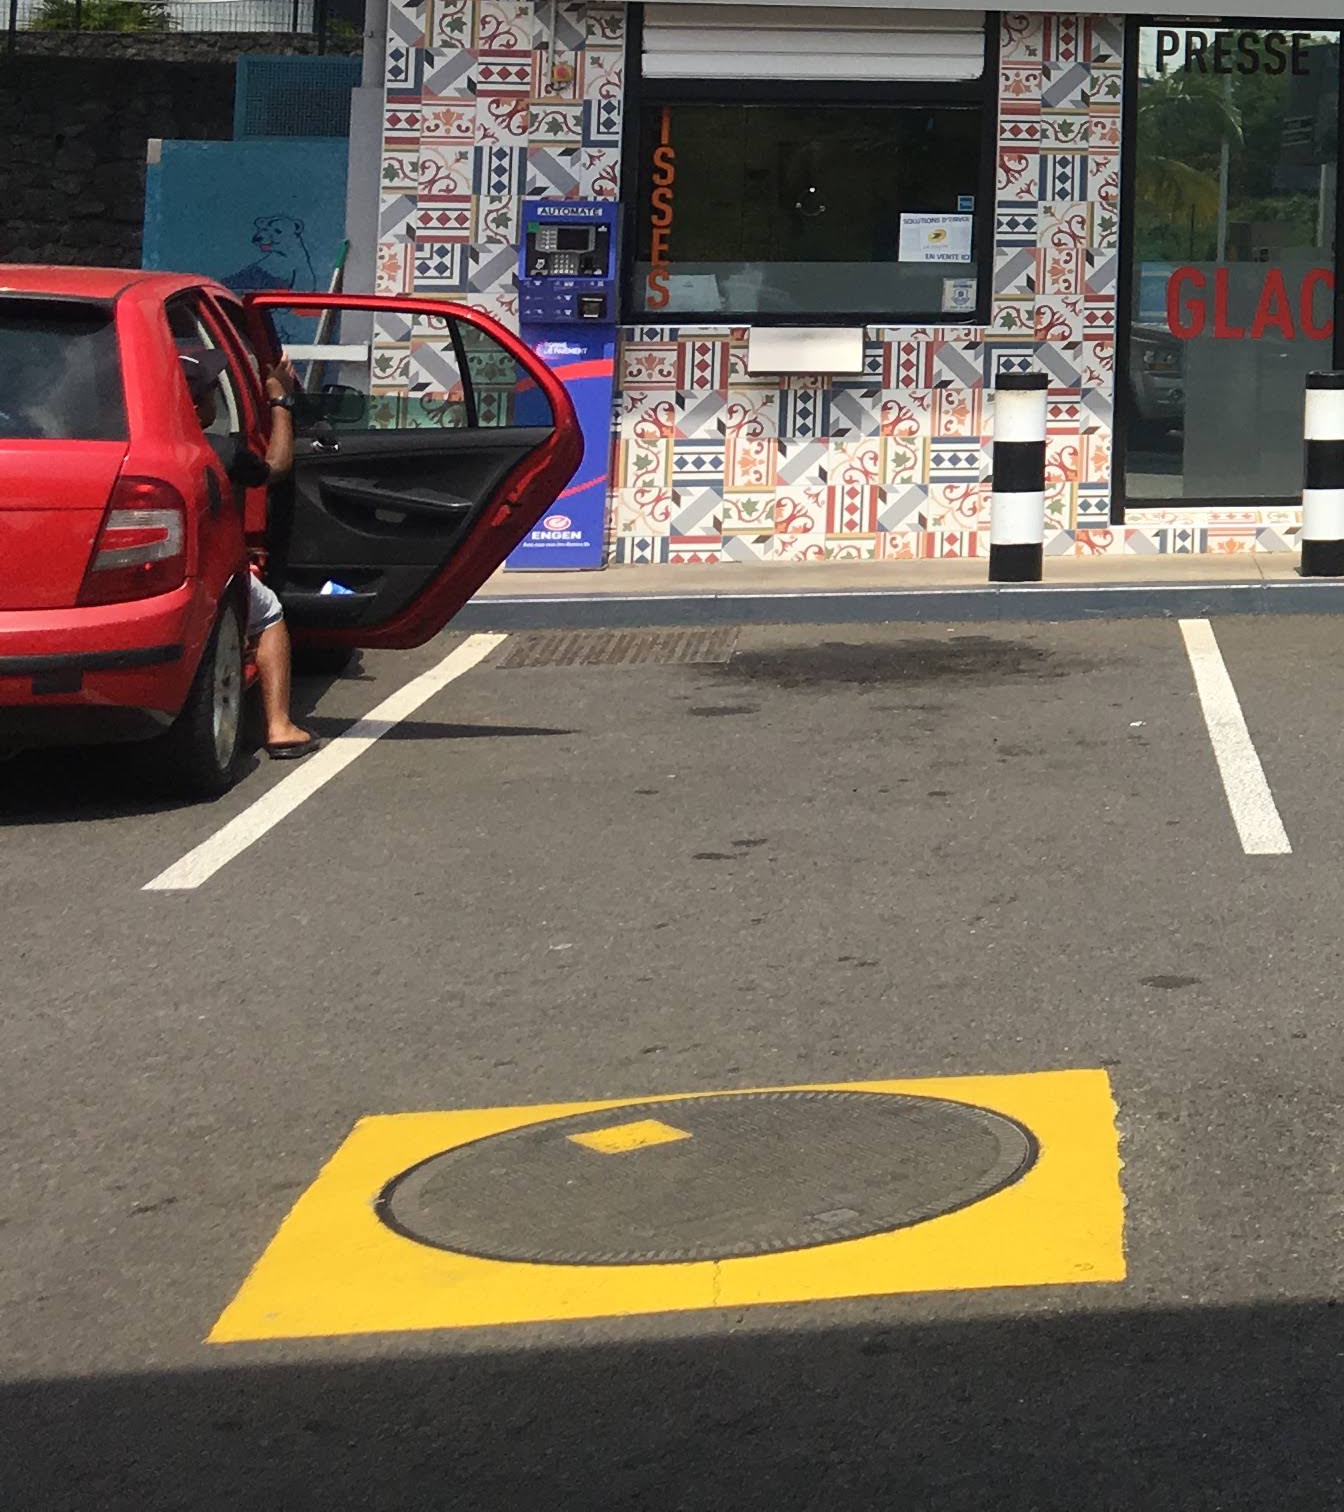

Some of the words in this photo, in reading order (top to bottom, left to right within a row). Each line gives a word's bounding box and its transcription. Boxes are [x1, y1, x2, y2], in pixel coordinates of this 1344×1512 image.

[1156, 29, 1312, 77] PRESSE
[540, 207, 601, 216] AUTOMATE
[531, 531, 582, 540] ENGEN
